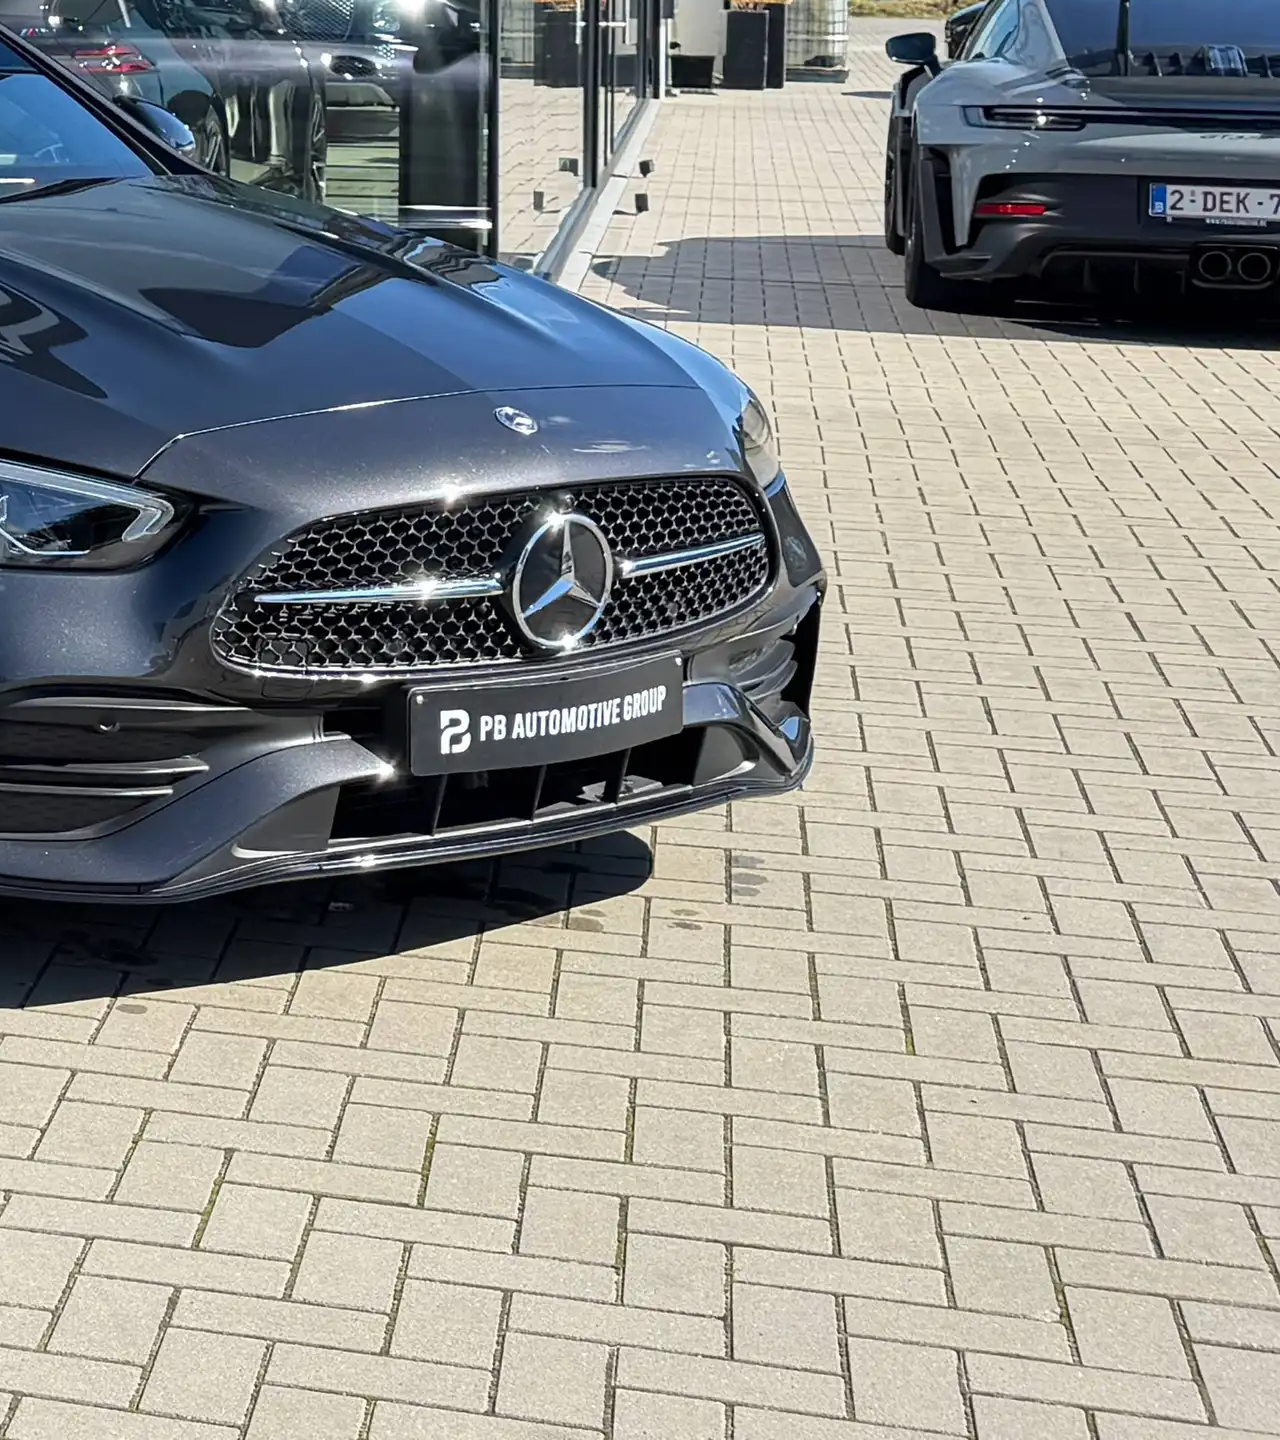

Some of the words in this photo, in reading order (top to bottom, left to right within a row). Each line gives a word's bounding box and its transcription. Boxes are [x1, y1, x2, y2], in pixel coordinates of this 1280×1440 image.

[479, 714, 507, 742] PB
[511, 697, 621, 740] AUTOMOTIVE
[622, 684, 667, 721] GROUP
